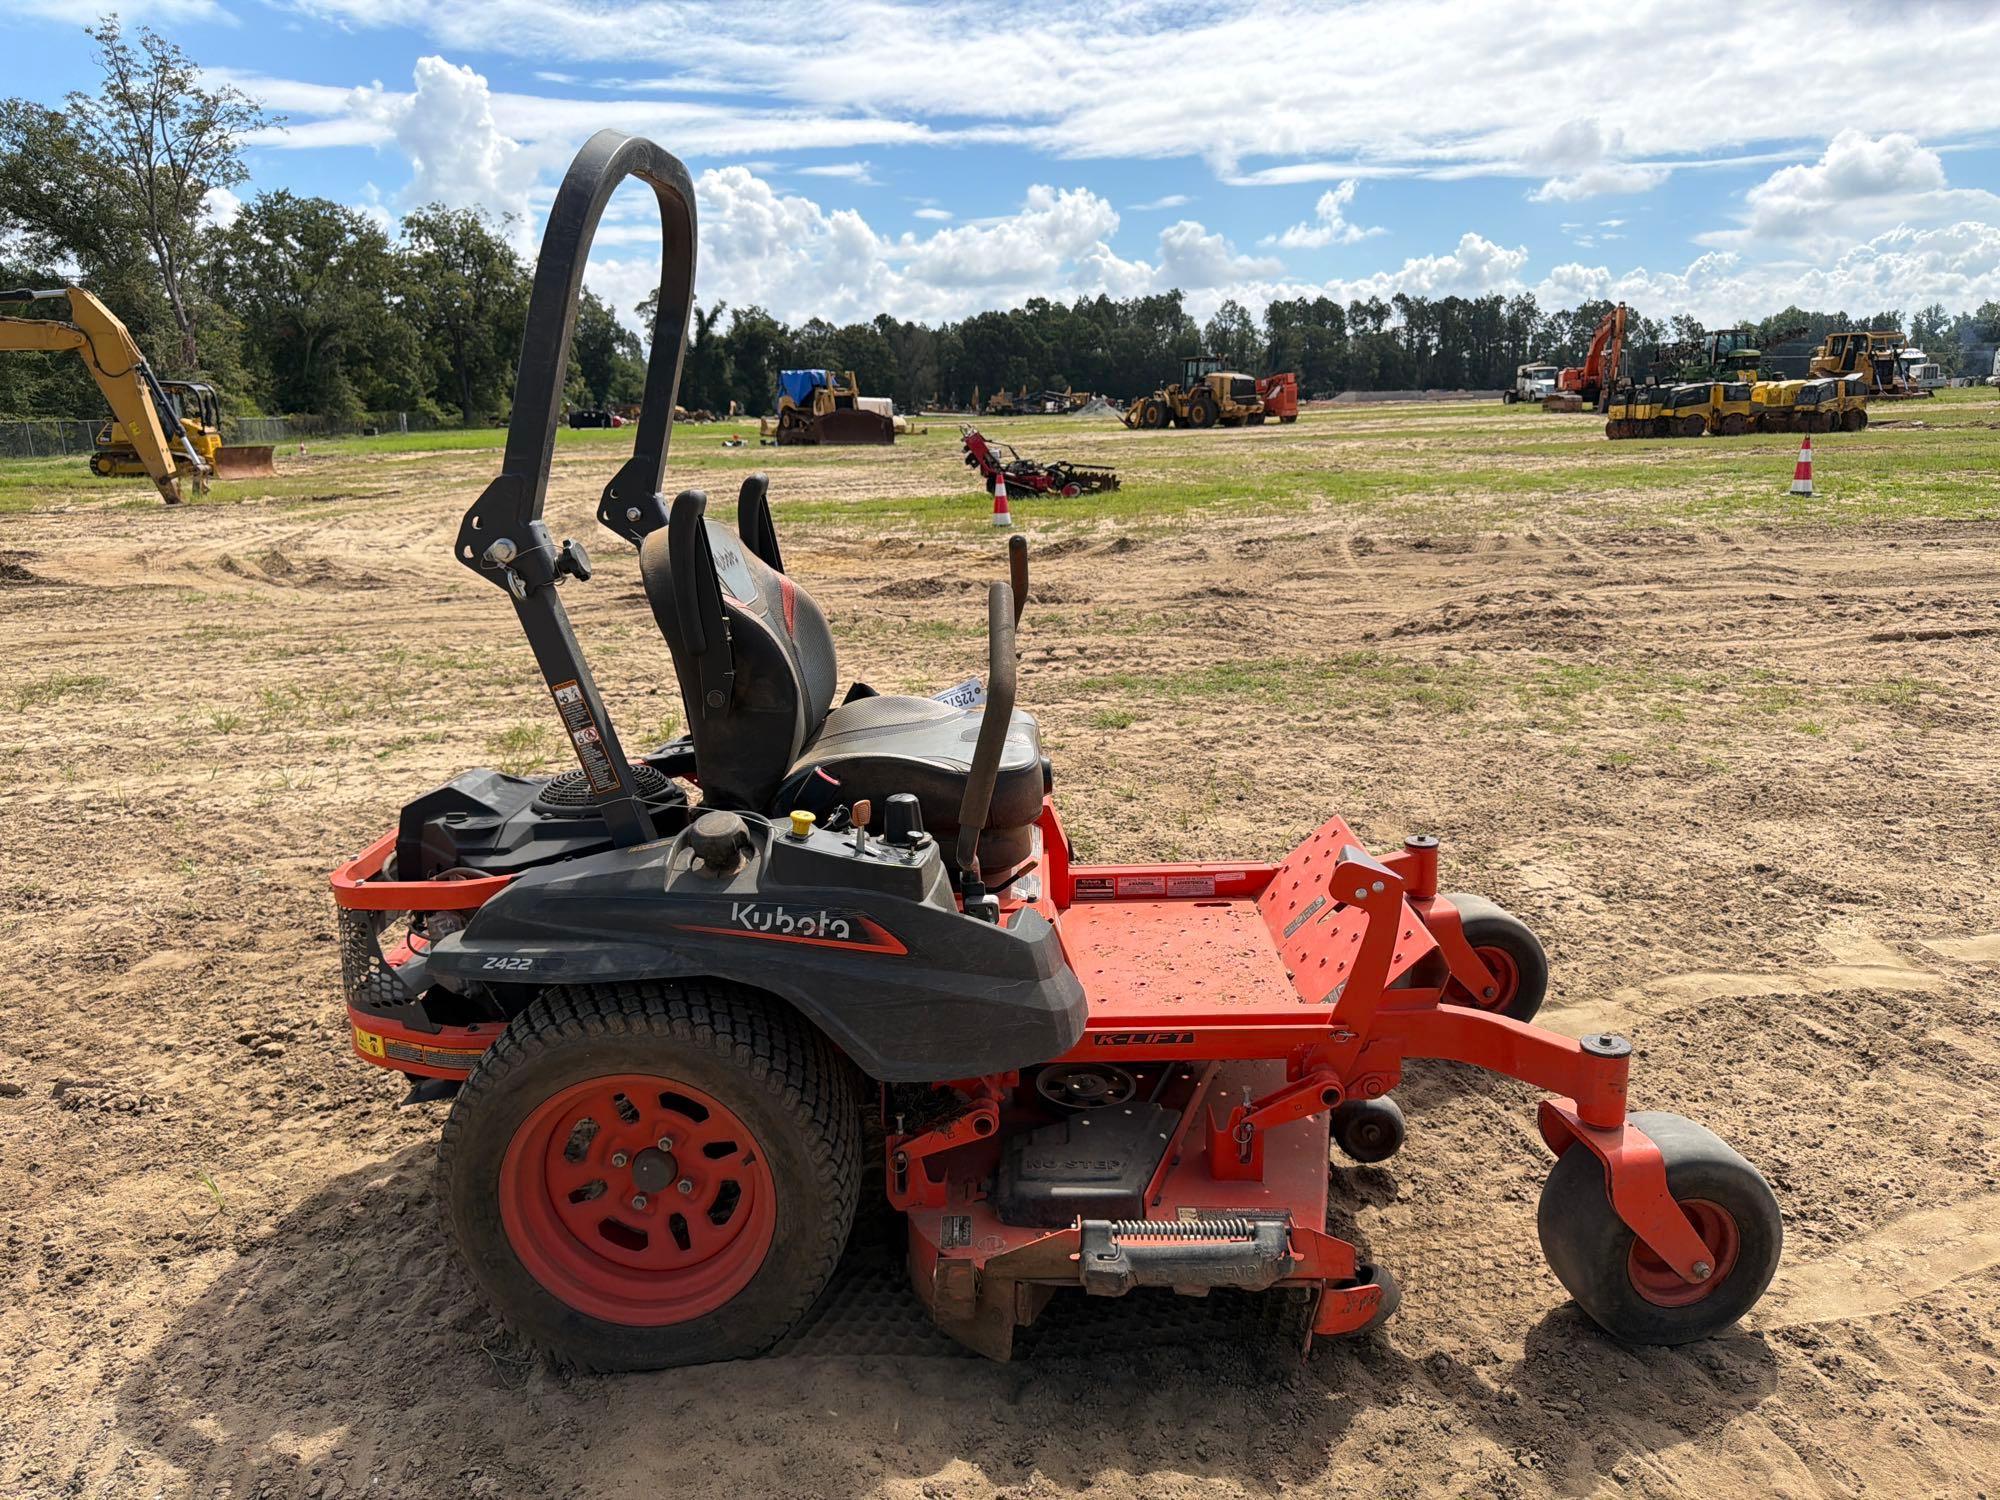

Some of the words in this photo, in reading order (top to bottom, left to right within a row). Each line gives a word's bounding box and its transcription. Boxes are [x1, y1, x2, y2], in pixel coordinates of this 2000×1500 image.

[731, 902, 850, 939] Kubota
[482, 957, 533, 971] Z422
[1098, 1032, 1192, 1045] K-LIFT
[1065, 1159, 1121, 1170] STEP
